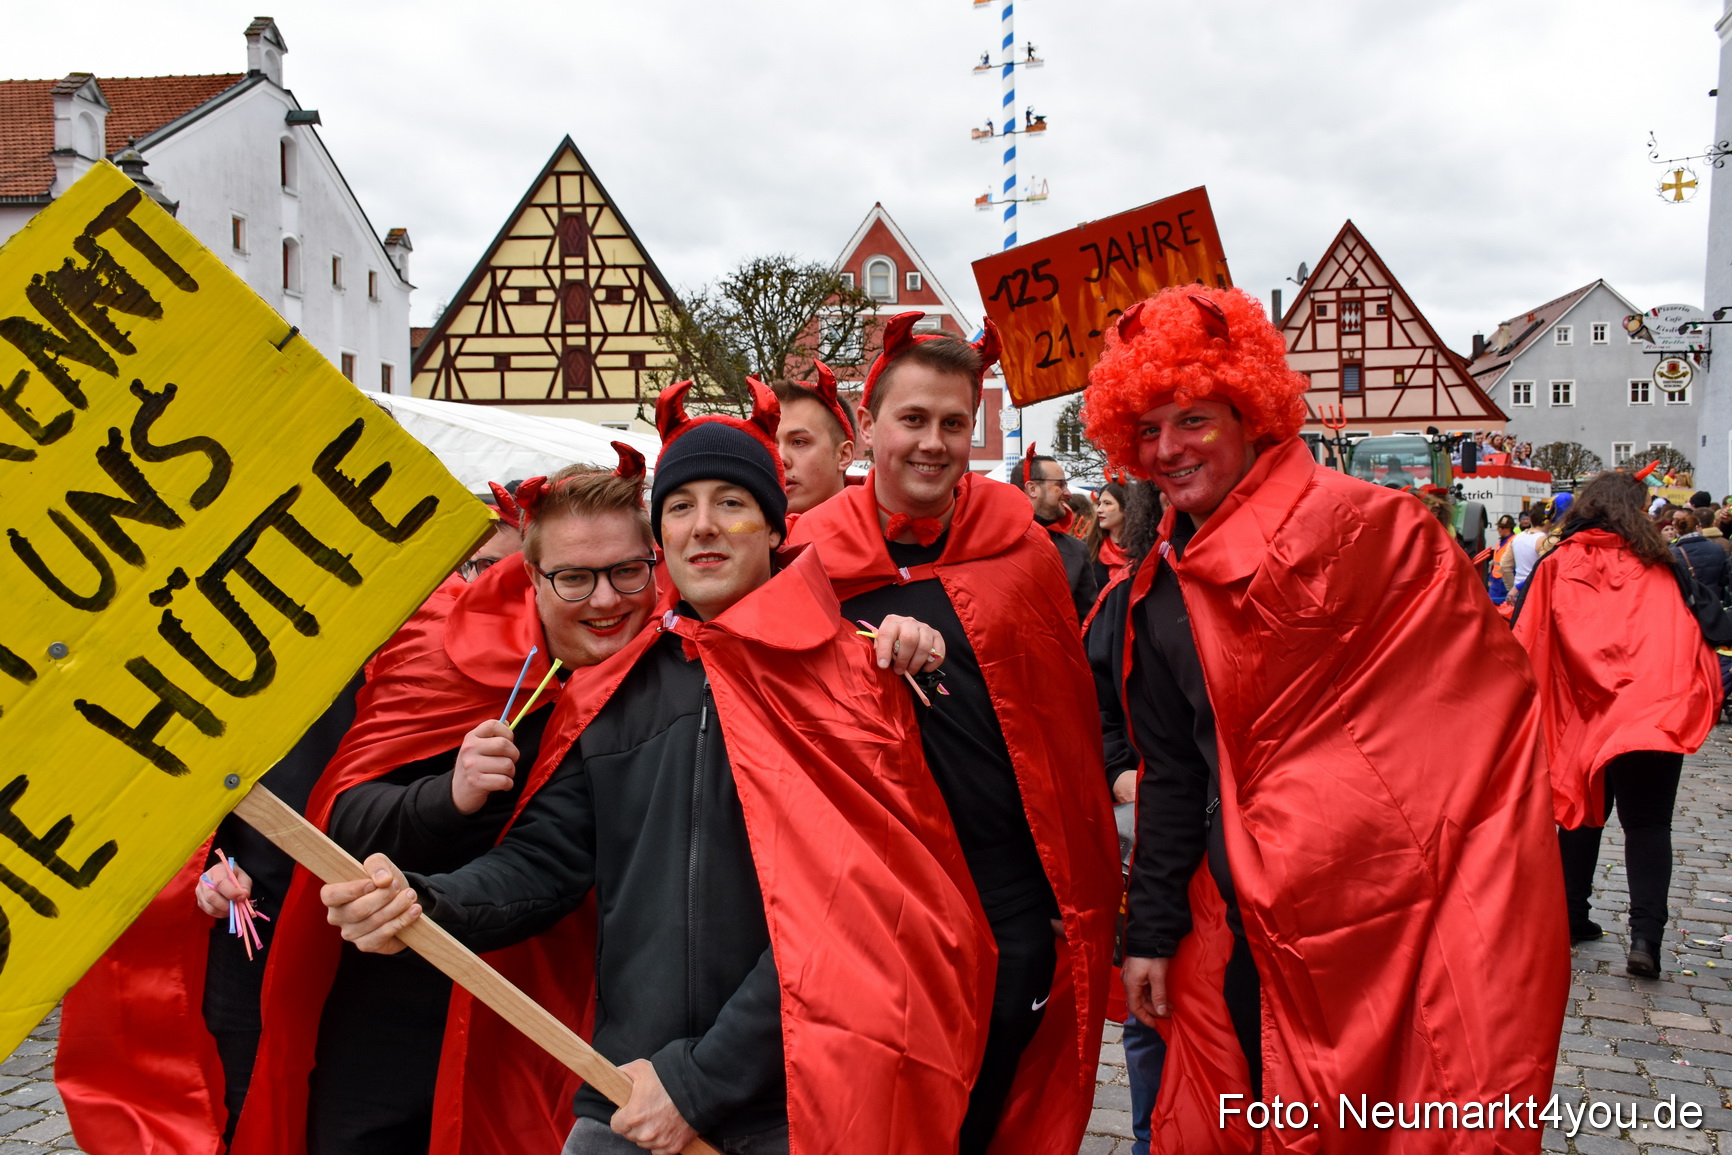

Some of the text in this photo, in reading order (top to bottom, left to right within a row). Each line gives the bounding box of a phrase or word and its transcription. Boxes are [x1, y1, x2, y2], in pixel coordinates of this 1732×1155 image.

[0, 187, 199, 463] ENNT
[988, 209, 1201, 312] 125 JAHRE
[7, 378, 233, 612] UNS
[74, 418, 440, 777] HÜTTE
[1462, 490, 1493, 500] strich
